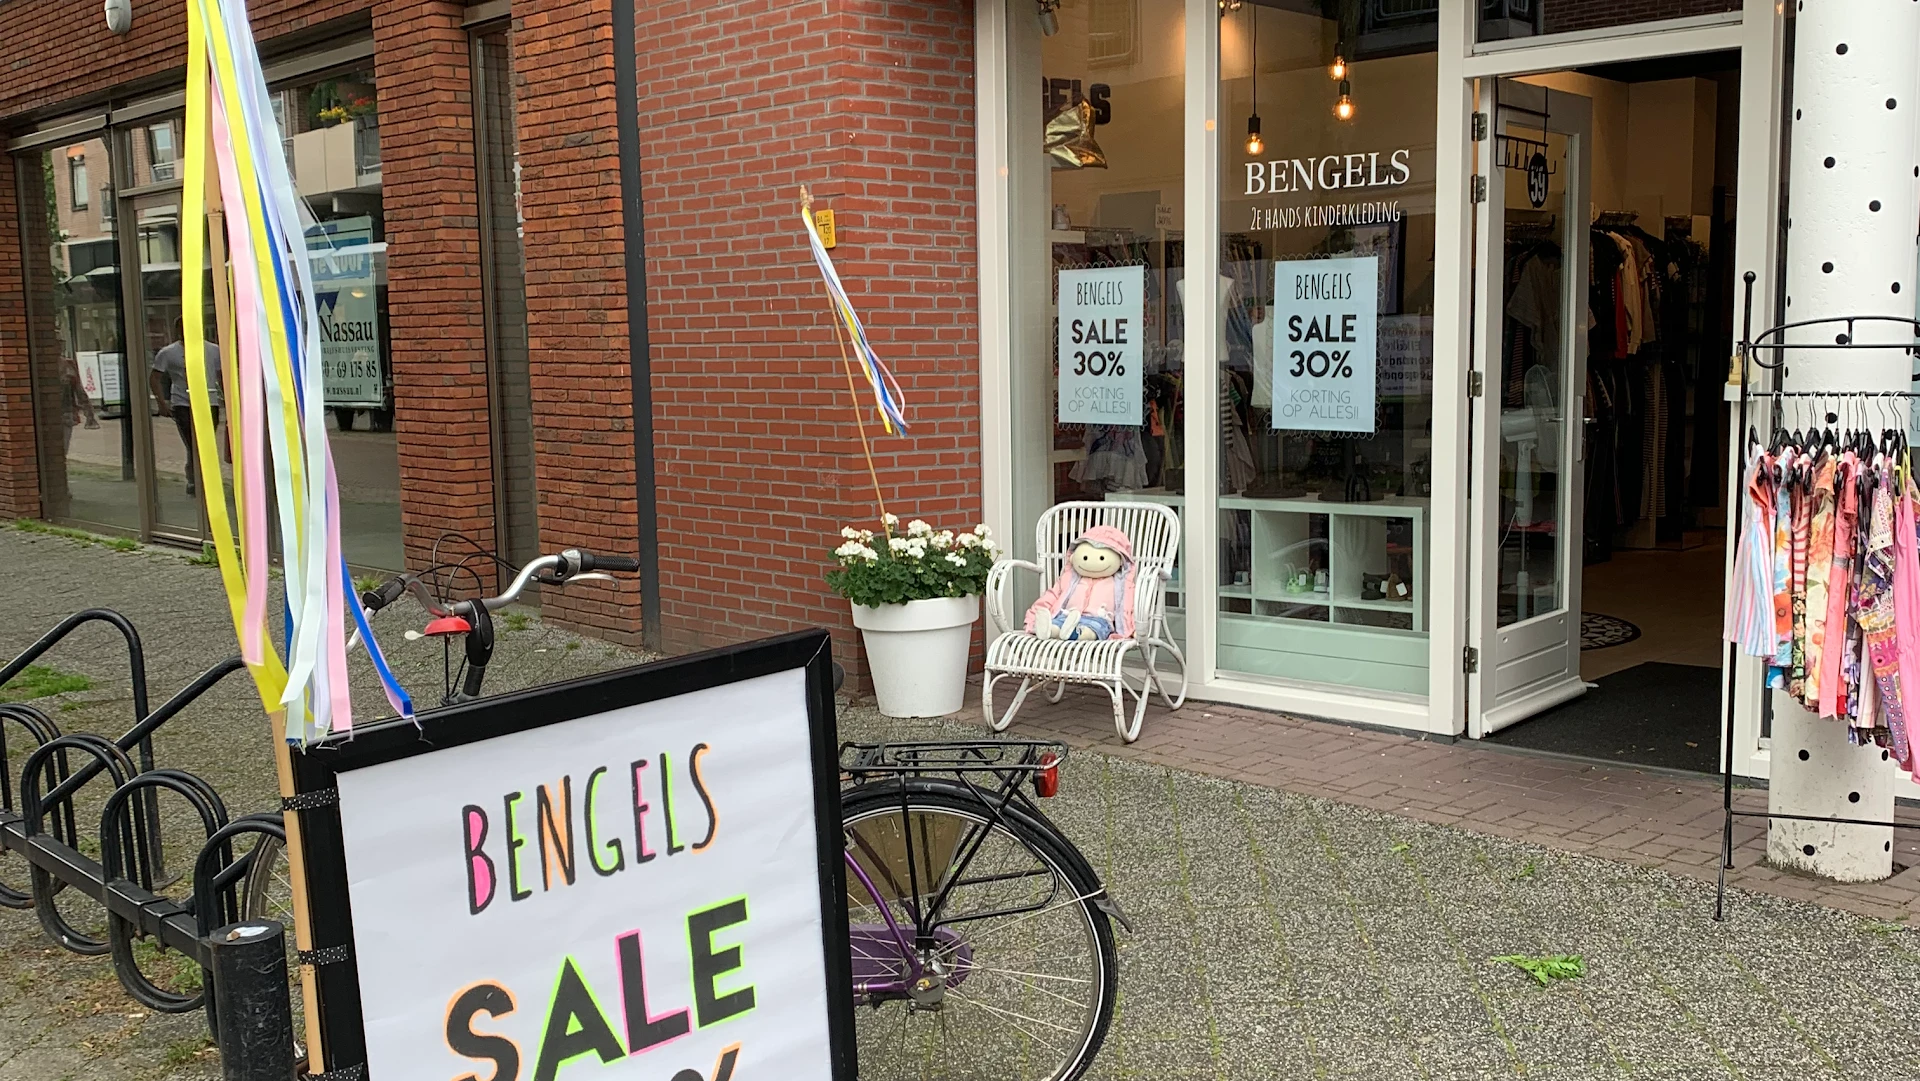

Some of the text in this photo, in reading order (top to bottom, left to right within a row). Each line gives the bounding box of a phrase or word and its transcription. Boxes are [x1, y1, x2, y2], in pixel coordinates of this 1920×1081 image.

[1244, 149, 1411, 195] BENGELS
[1250, 200, 1401, 231] 2E HANDS KINDERKLEDING
[1076, 280, 1123, 306] BENGELS
[1295, 272, 1352, 301] BENGELS
[319, 314, 374, 343] Nassau
[1071, 318, 1128, 344] SALE
[1287, 314, 1357, 343] SALE
[322, 345, 375, 355] RIJFSHUISVESTING
[1073, 350, 1125, 376] 30%
[336, 360, 347, 378] 69
[350, 360, 363, 378] 175
[366, 360, 377, 378] 85
[1289, 350, 1353, 379] 30%
[323, 384, 362, 396] w.nassau.nl
[1074, 386, 1125, 400] KORTING
[1290, 389, 1351, 404] KORTING
[1068, 400, 1131, 414] OP ALLES!!
[1282, 404, 1359, 420] OP ALLES!!
[461, 742, 720, 916] BENGELS
[444, 893, 757, 1081] SALE
